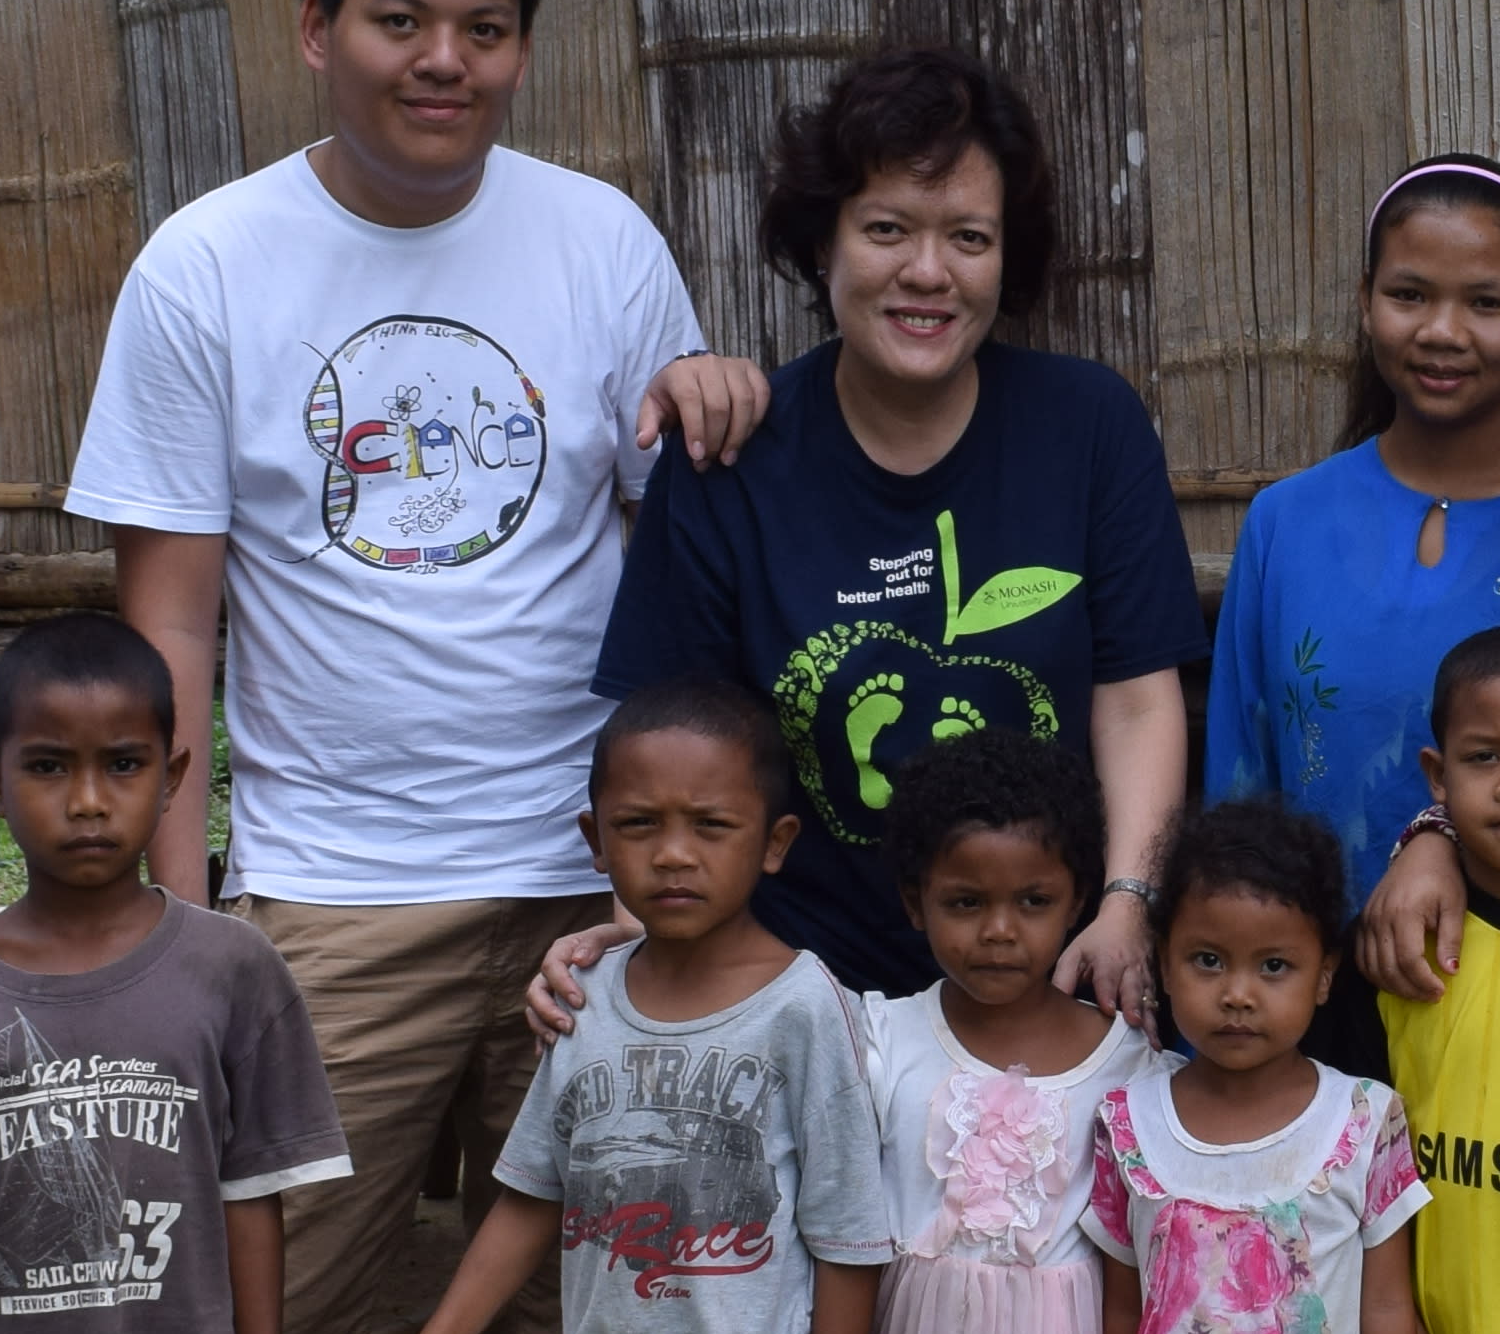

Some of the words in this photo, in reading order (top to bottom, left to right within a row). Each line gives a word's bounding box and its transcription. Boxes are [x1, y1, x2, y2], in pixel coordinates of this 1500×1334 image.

[369, 323, 418, 342] THINK
[425, 325, 451, 338] BIG
[869, 548, 933, 572] Stepping
[886, 569, 911, 584] out
[913, 564, 934, 579] for
[837, 589, 883, 605] better
[885, 581, 931, 600] health
[999, 579, 1057, 600] MONASH
[28, 1058, 82, 1088] SEA
[84, 1054, 158, 1079] Services
[101, 1078, 174, 1099] SEAMAN
[607, 1201, 775, 1273] Race
[25, 1265, 72, 1289] SAIL
[649, 1281, 692, 1300] Team
[11, 1296, 58, 1313] SERVICE
